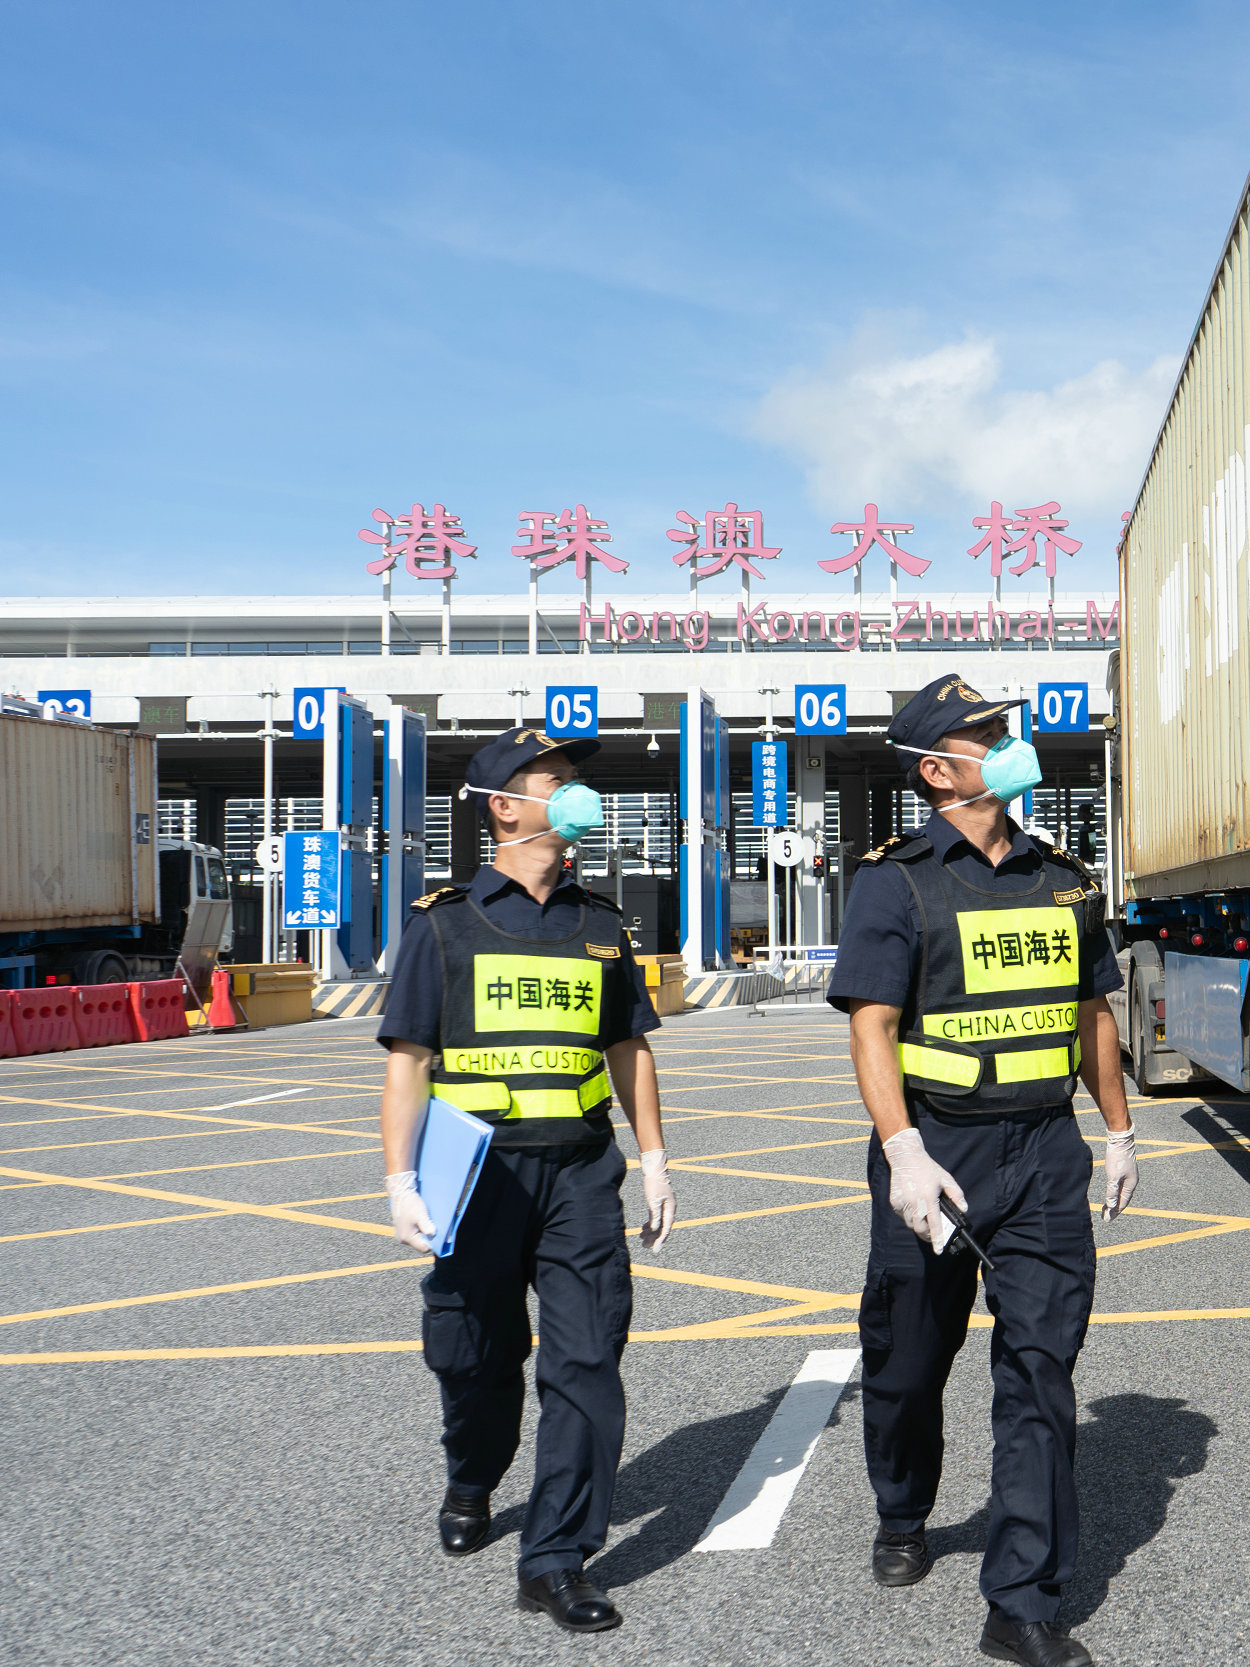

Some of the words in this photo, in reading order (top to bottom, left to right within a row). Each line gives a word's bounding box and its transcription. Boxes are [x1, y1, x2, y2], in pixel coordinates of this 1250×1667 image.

[357, 501, 1130, 579] 港珠澳大桥
[579, 601, 709, 650] Hong
[298, 695, 325, 730] 0
[551, 694, 593, 728] 05
[800, 692, 841, 727] 06
[1043, 690, 1083, 724] 07
[762, 744, 777, 824] 跨境电商专用道
[271, 844, 279, 863] 5
[783, 840, 792, 858] 5
[302, 836, 322, 924] 珠澳货车道
[972, 929, 1072, 969] 中国海关
[487, 976, 594, 1013] 中国海关
[942, 1014, 1016, 1038] CHINA
[1021, 1007, 1077, 1031] CUSTO
[456, 1052, 523, 1071] CHINA
